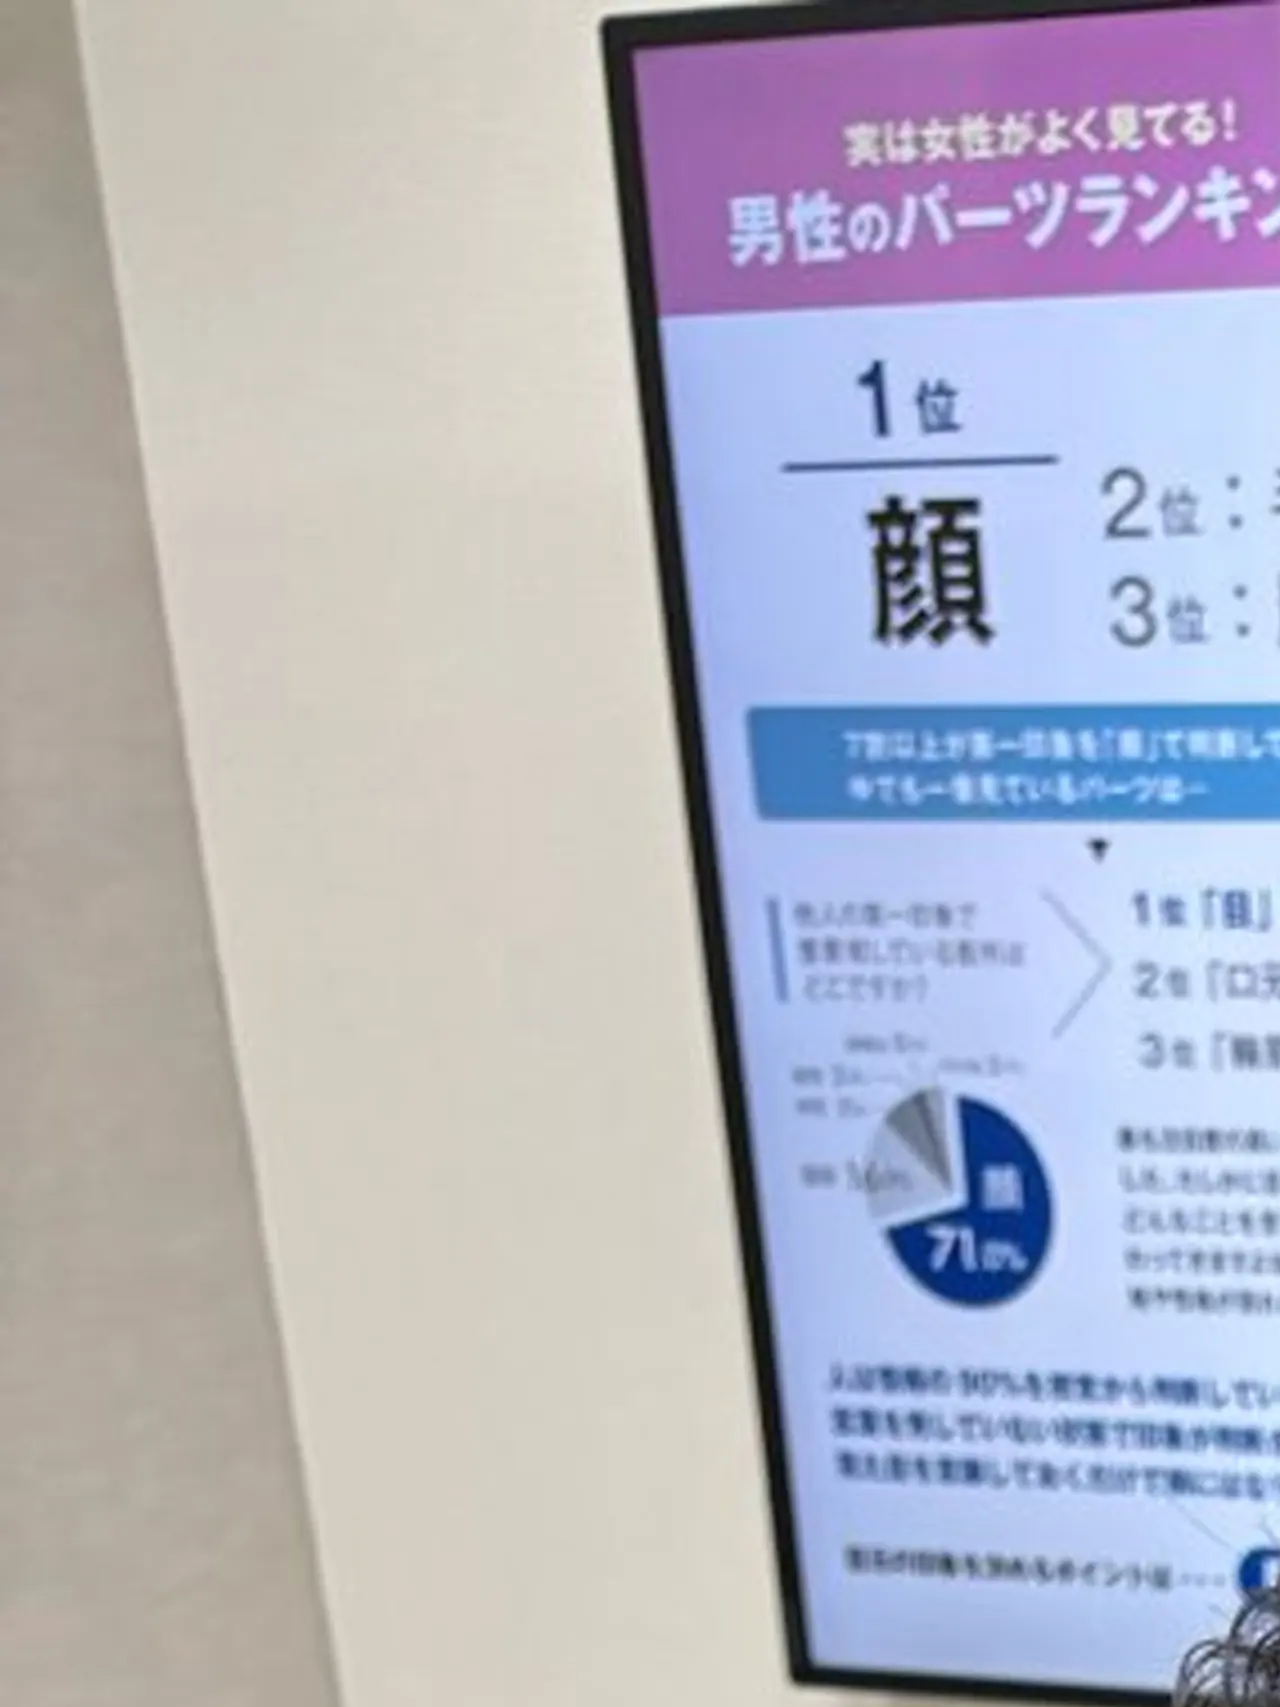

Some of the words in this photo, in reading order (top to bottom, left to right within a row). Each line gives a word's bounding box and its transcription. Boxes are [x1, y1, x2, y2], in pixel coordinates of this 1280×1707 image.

[844, 101, 1238, 168] 実は女性がよく見てる!
[867, 496, 998, 647] 顔
